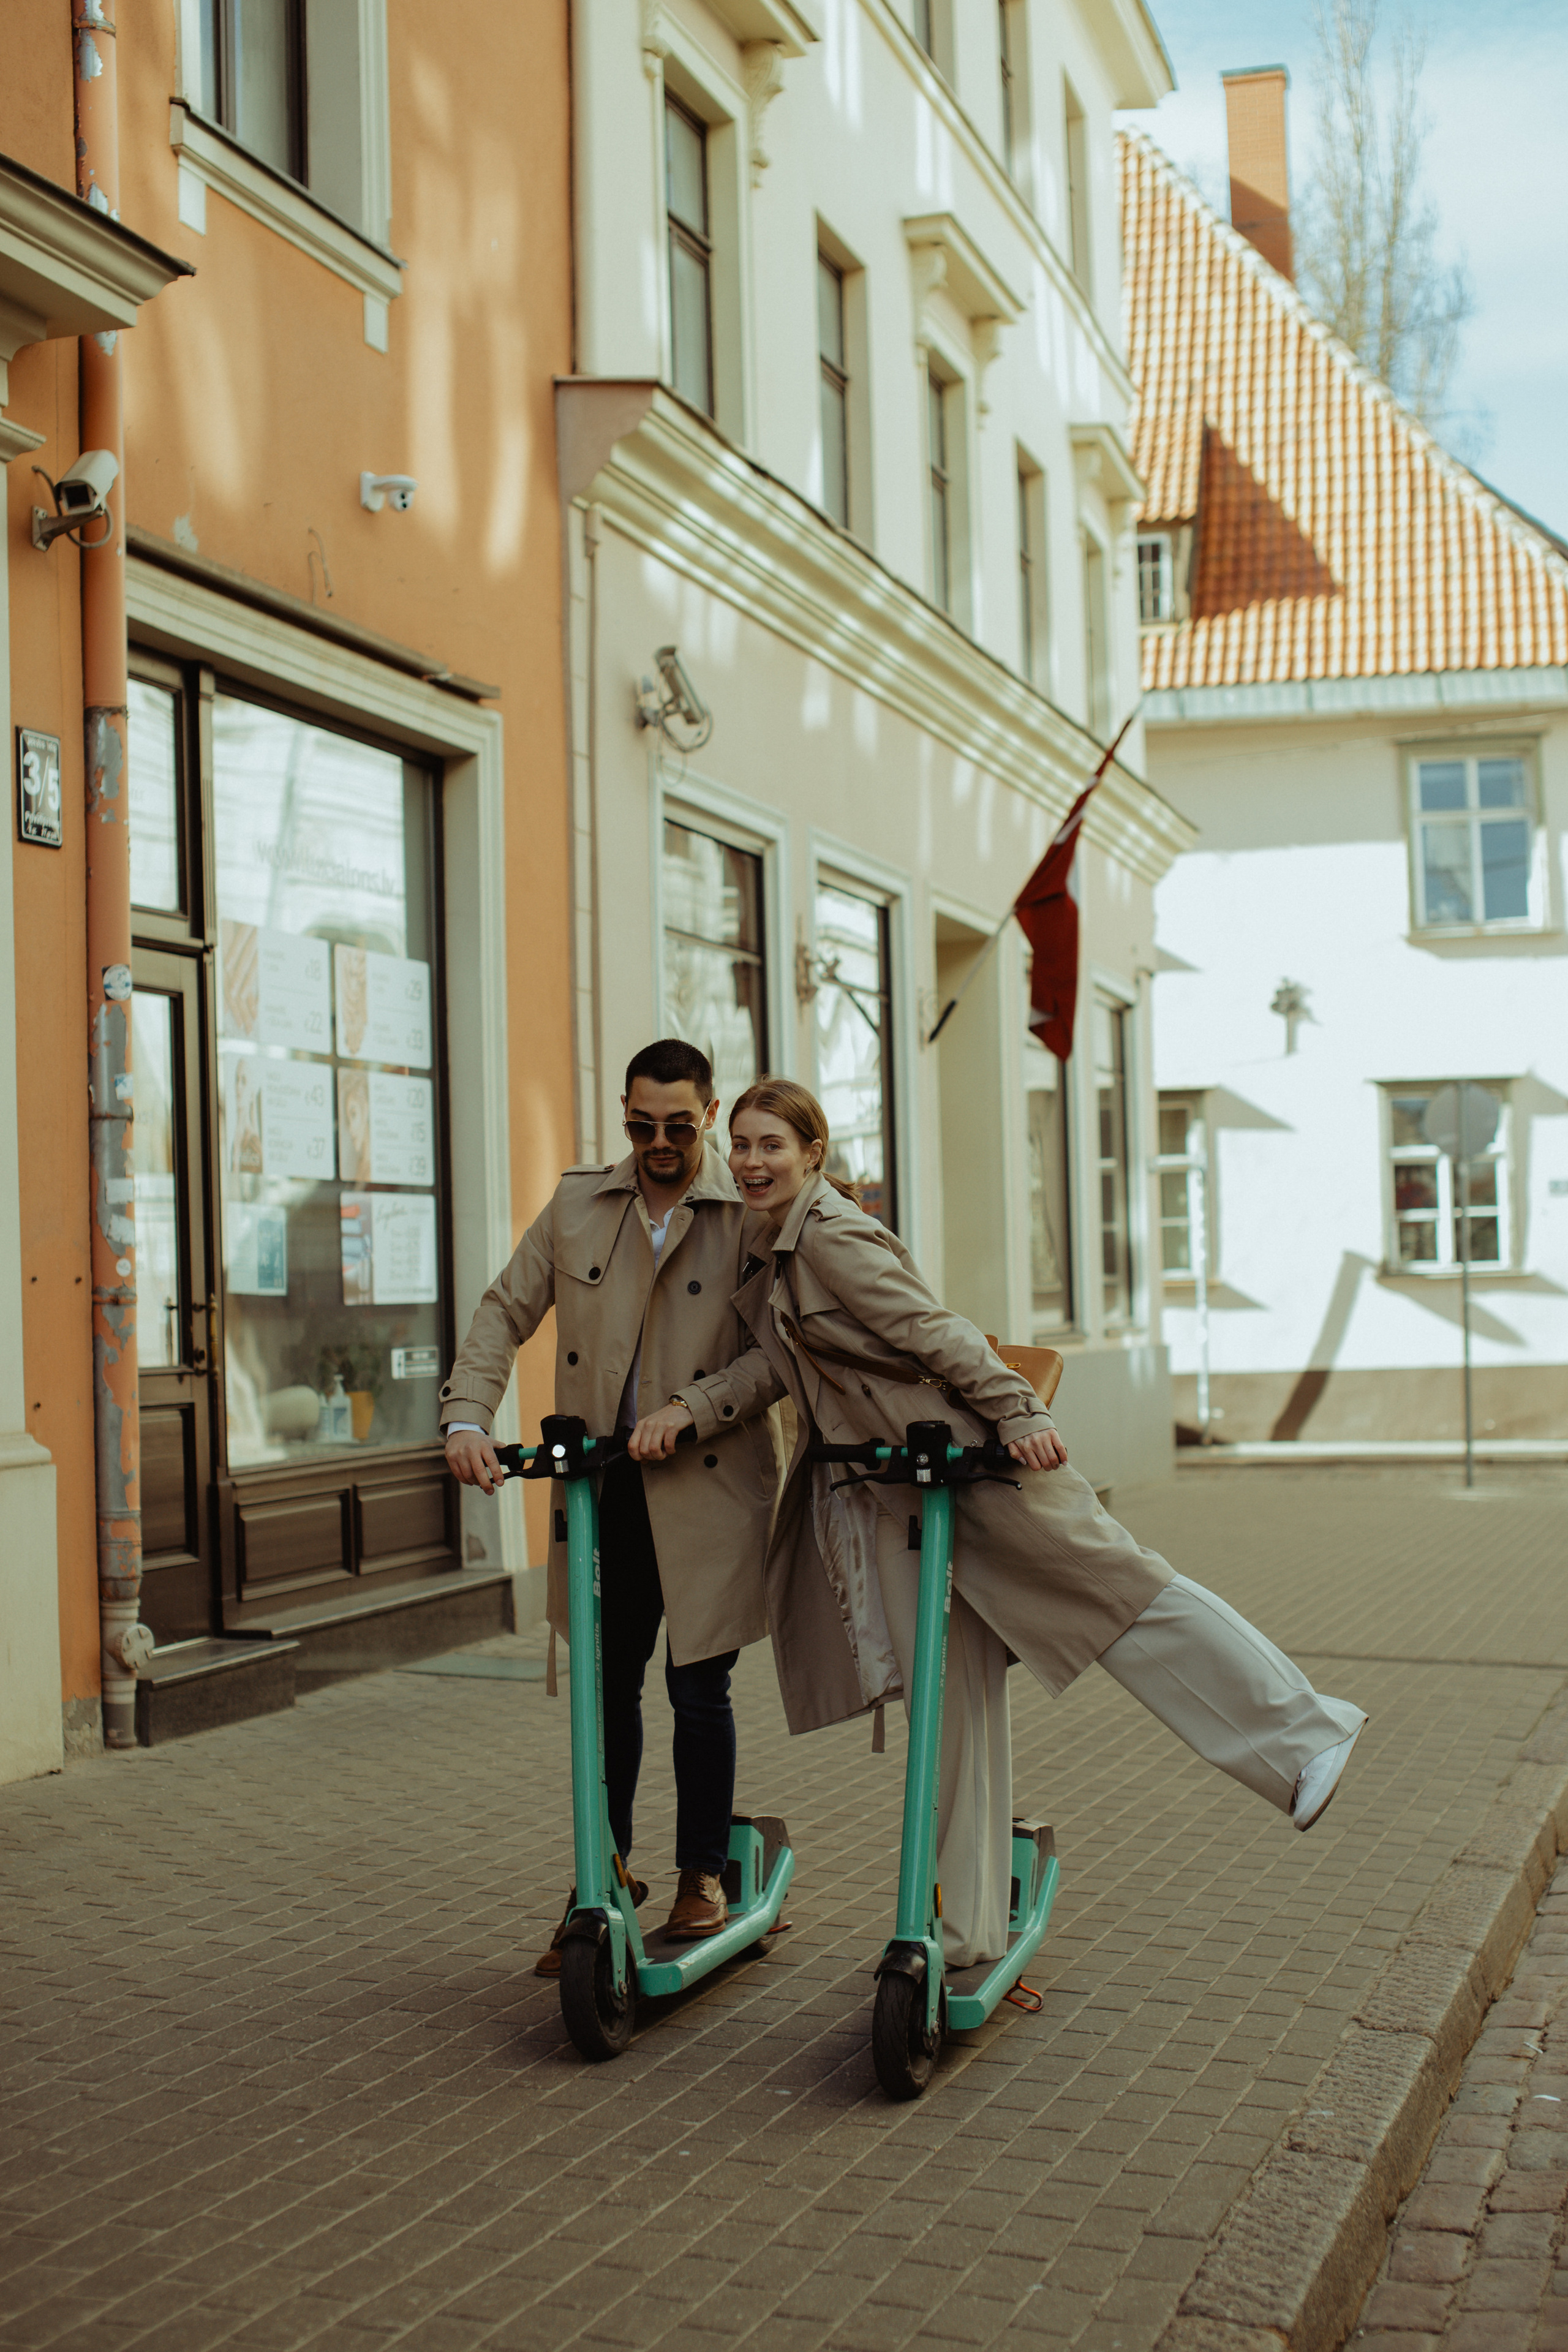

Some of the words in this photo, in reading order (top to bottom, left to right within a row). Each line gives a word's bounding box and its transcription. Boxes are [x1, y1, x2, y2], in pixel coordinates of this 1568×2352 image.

[23, 751, 59, 812] 3/5
[593, 1547, 601, 1598] Bolt
[944, 1561, 953, 1614] Bolt
